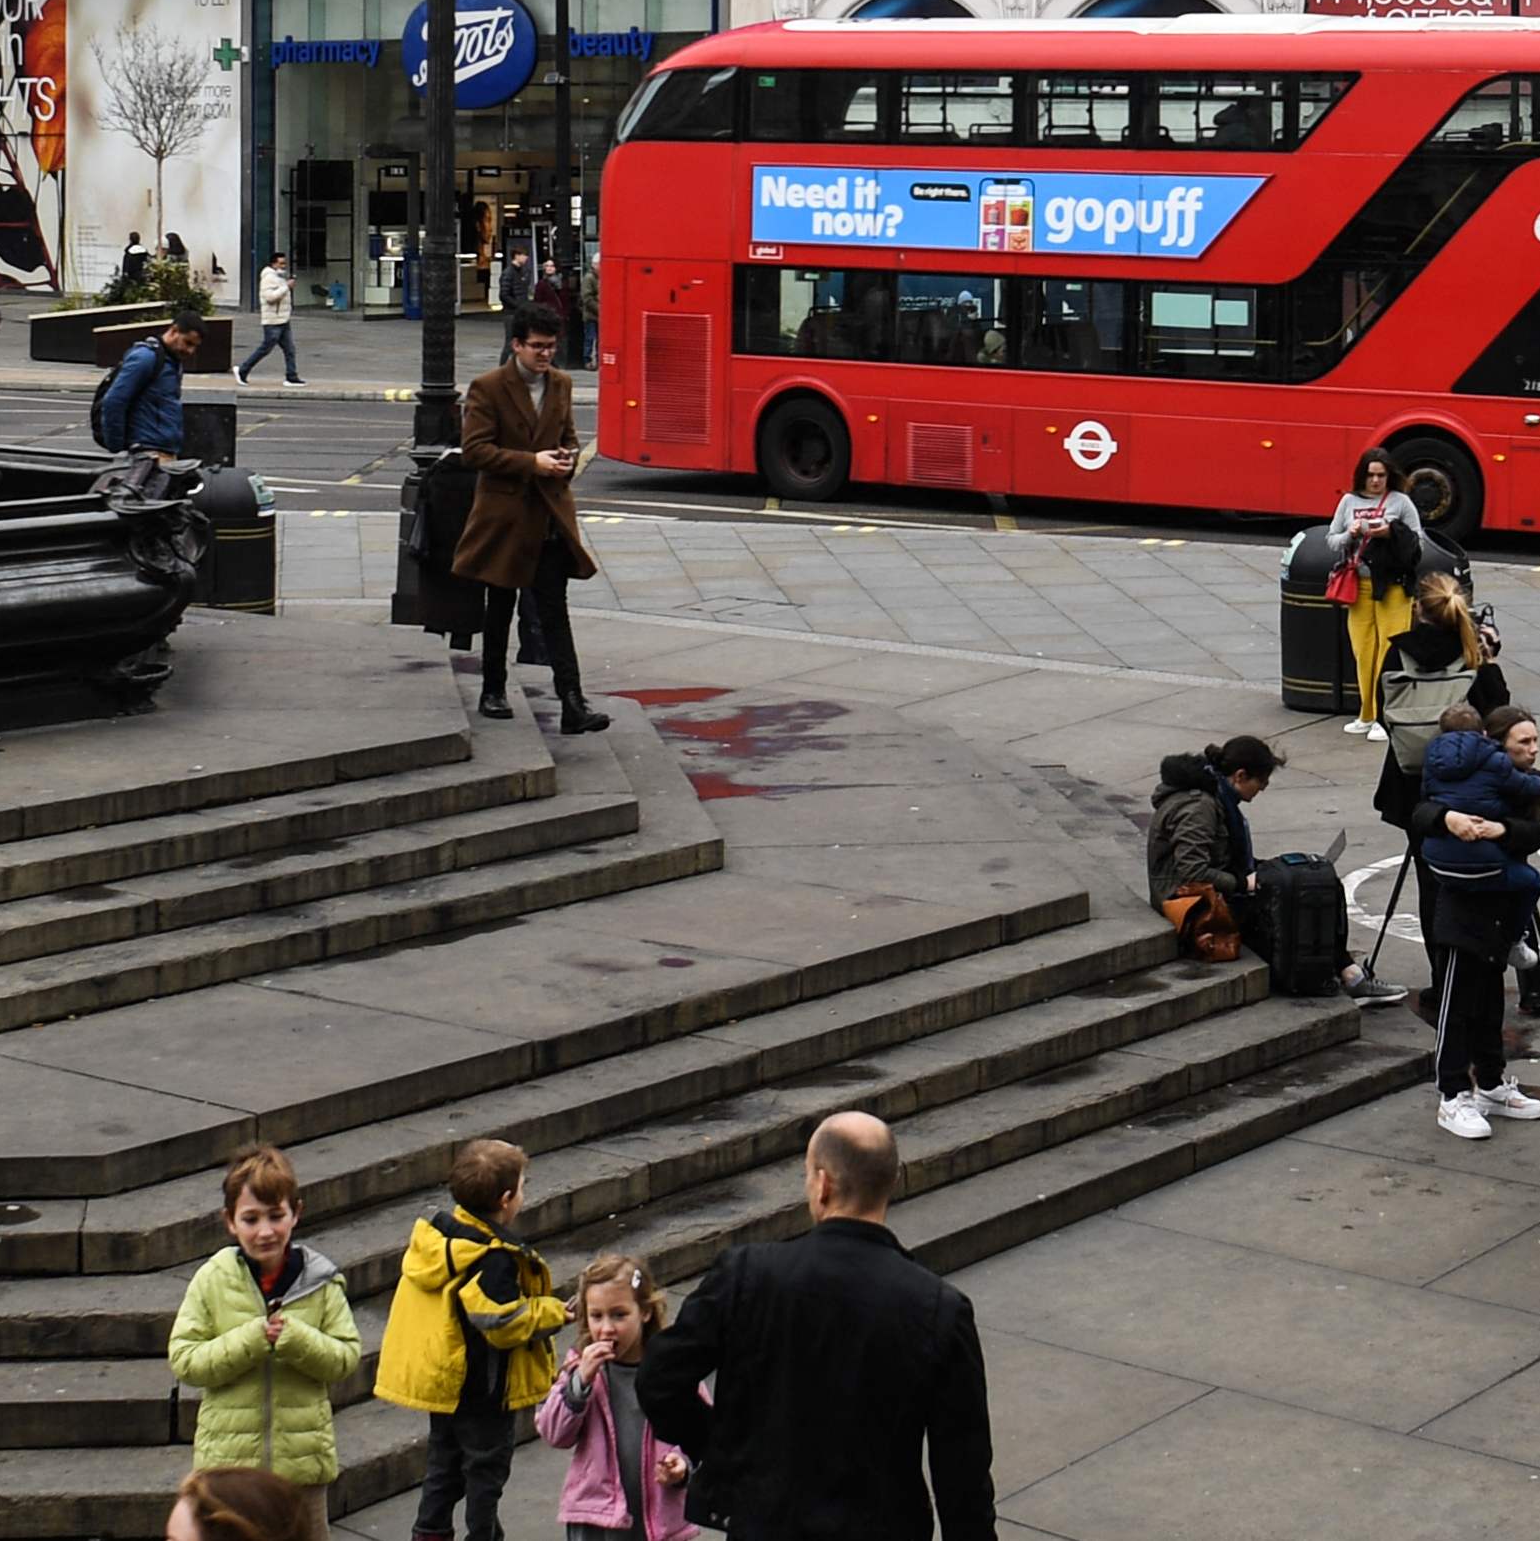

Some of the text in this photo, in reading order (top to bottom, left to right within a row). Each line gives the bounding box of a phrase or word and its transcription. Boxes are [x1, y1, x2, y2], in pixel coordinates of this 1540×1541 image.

[271, 35, 381, 69] pharmacy
[568, 26, 654, 62] beauty
[761, 175, 881, 209] Need it
[812, 205, 903, 238] now?
[1044, 186, 1204, 247] gopuff
